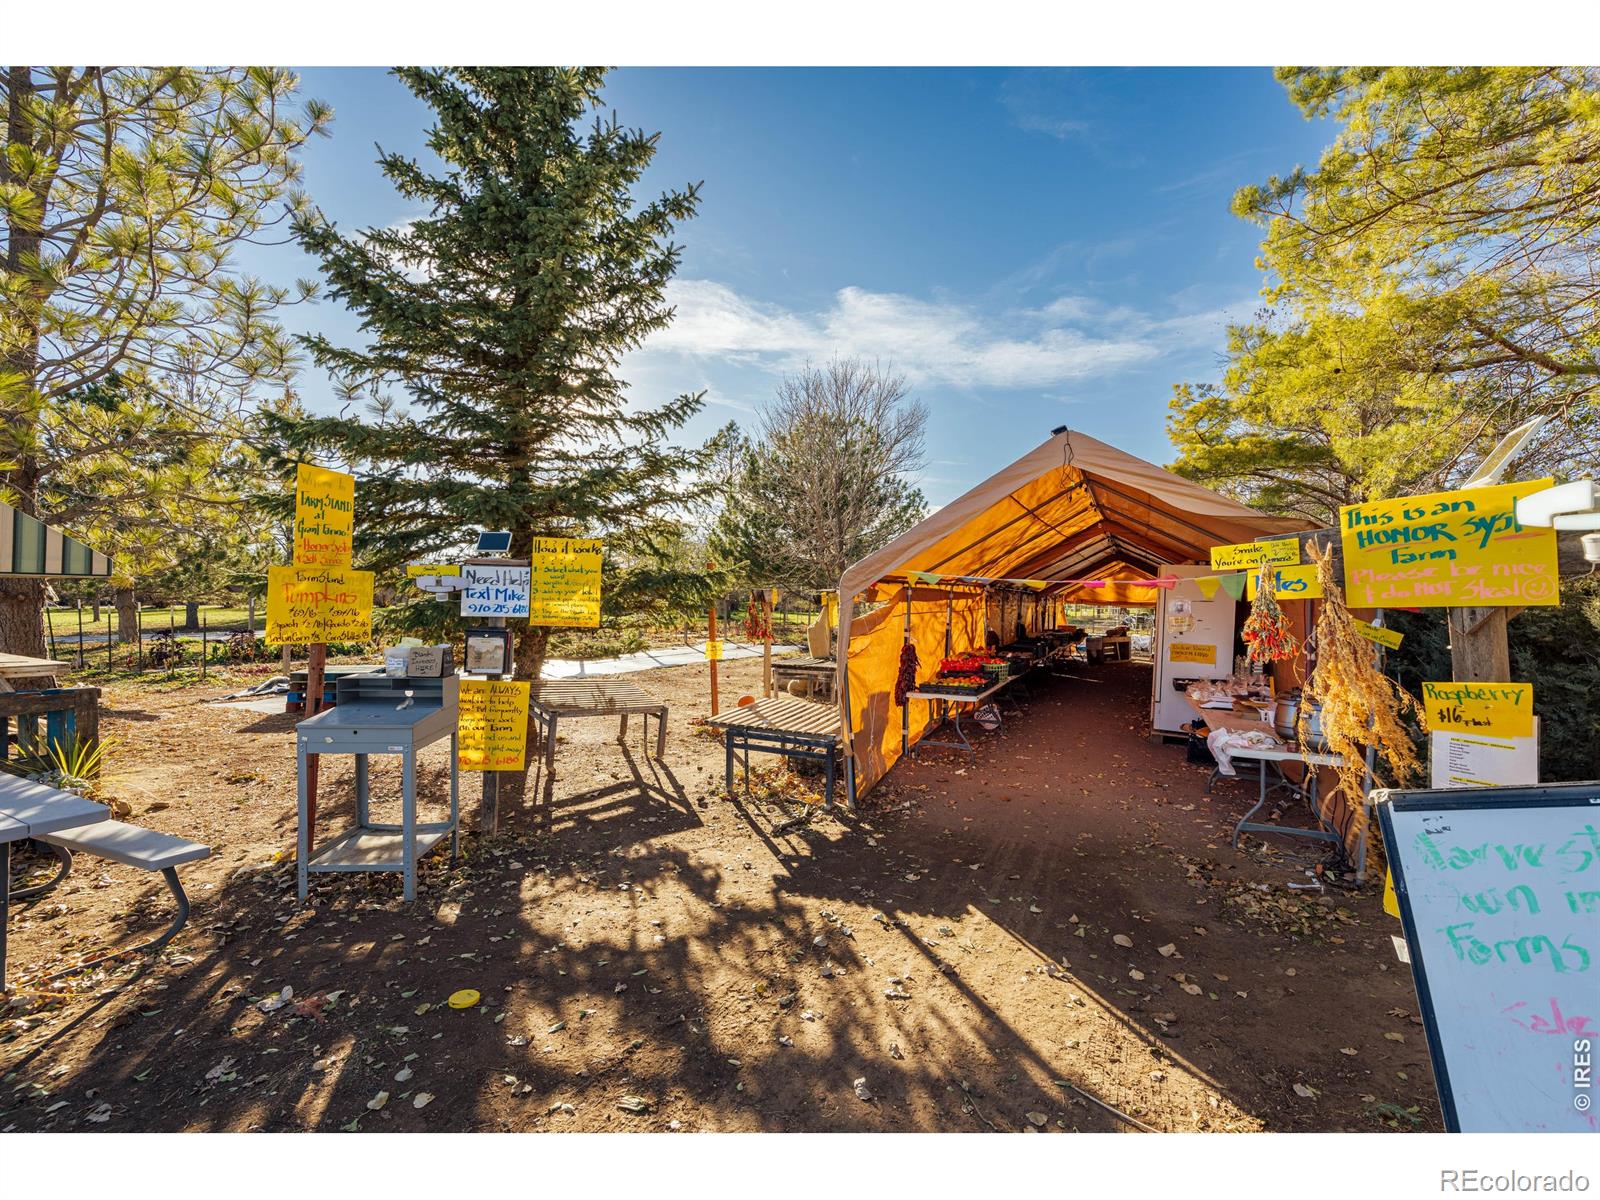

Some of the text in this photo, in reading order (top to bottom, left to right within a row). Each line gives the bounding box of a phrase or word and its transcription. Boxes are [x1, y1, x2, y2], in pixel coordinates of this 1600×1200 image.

[1347, 499, 1476, 529] This is an
[1357, 521, 1458, 549] HONOR
[535, 540, 557, 553] How
[1233, 544, 1263, 555] Smile
[1390, 546, 1457, 565] Farm
[1214, 556, 1243, 568] You're
[466, 569, 500, 585] Need
[1352, 561, 1548, 586] Please be nice
[282, 582, 357, 608] Pumpkins
[465, 586, 491, 601] Text
[495, 588, 526, 602] Mike
[1381, 584, 1411, 600] do
[1458, 580, 1520, 601] Steal
[1424, 683, 1524, 705] Raspberry
